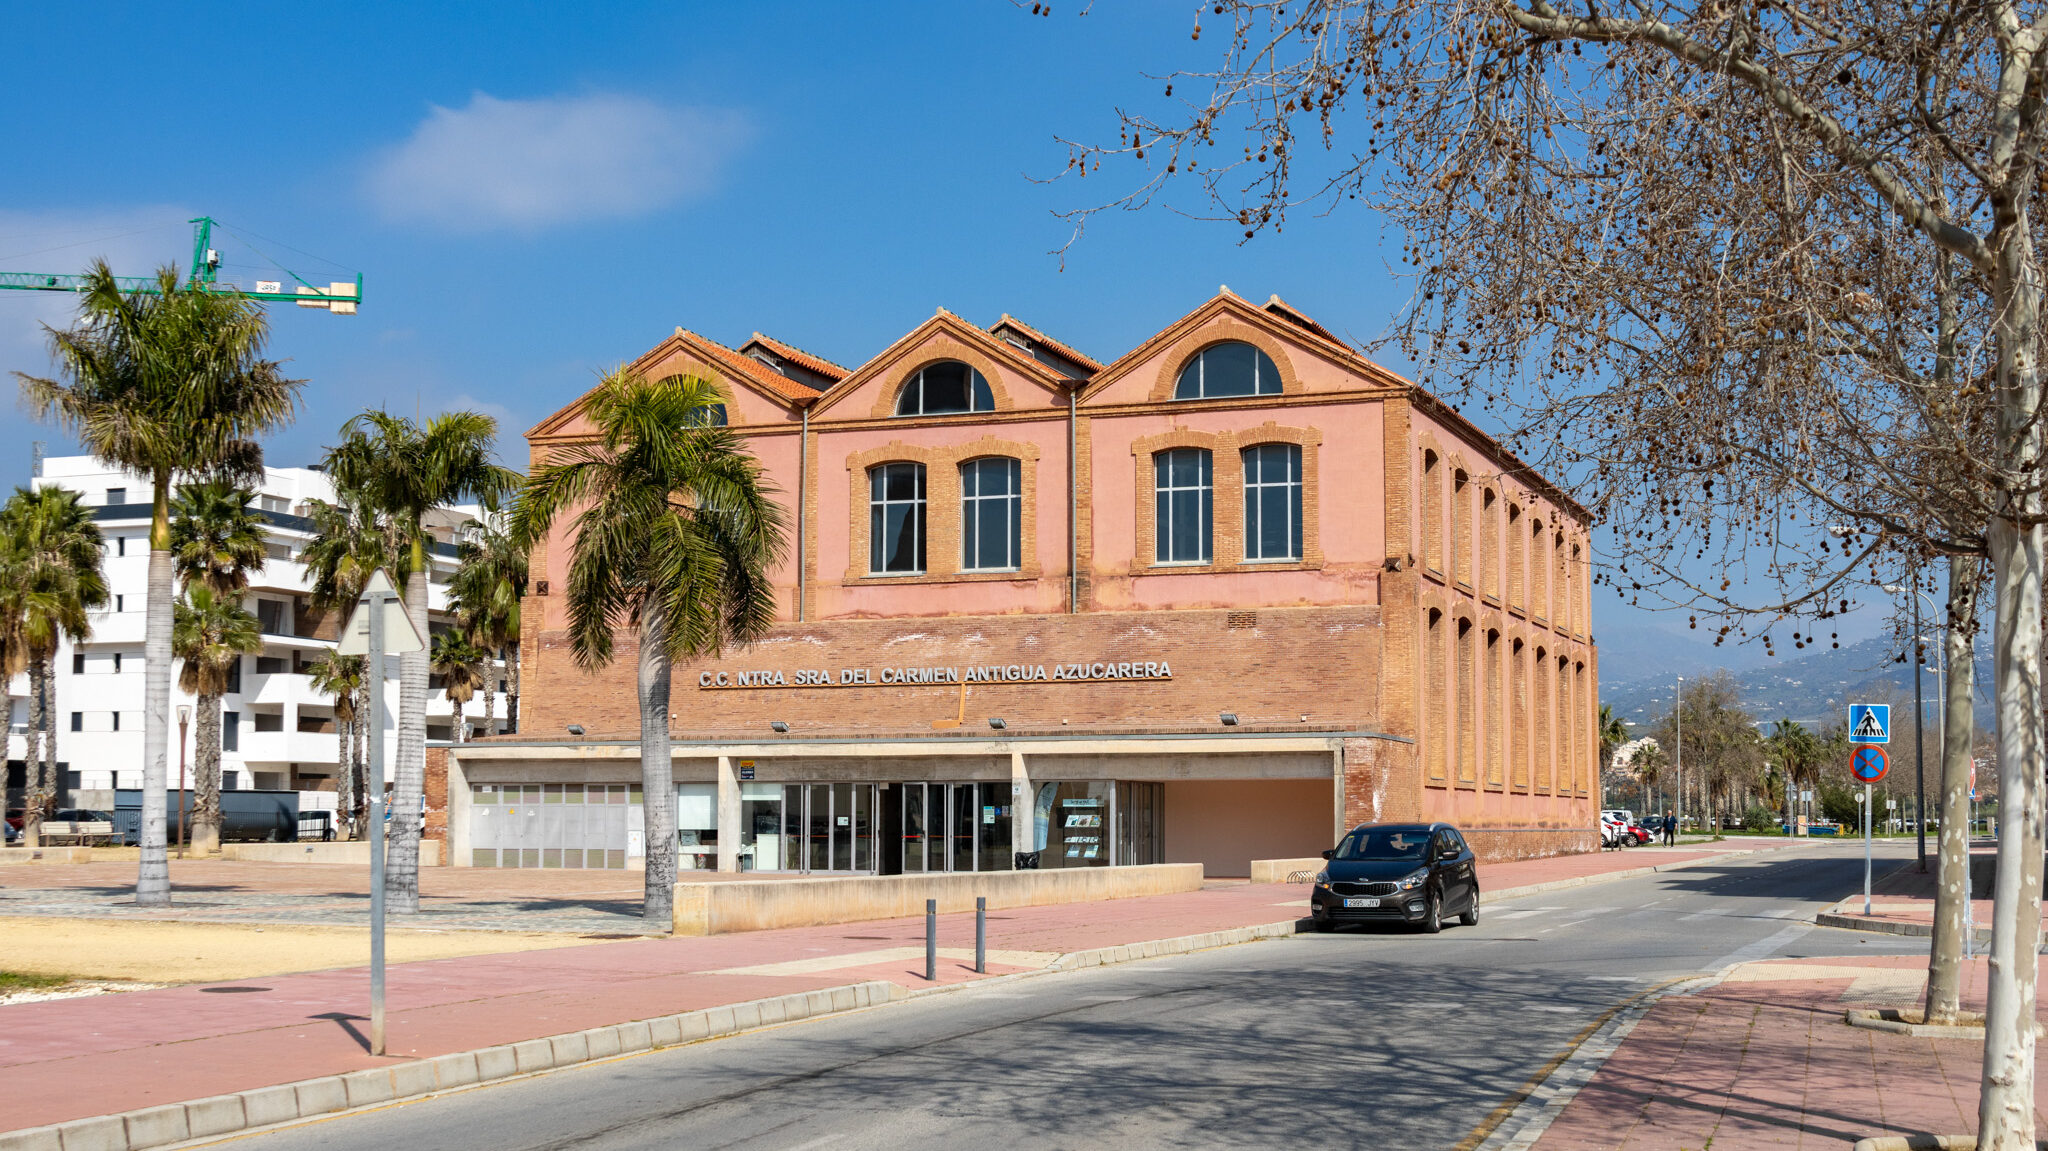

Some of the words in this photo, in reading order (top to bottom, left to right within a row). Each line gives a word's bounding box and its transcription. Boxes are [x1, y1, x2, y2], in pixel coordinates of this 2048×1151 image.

[699, 671, 733, 687] C.C.
[737, 670, 789, 686] NTRA.
[795, 669, 835, 685] SRA.
[840, 668, 876, 684] DEL
[880, 667, 958, 683] CARMEN
[964, 664, 1047, 682] ANTIGUA
[1052, 661, 1172, 680] AZUCARERA
